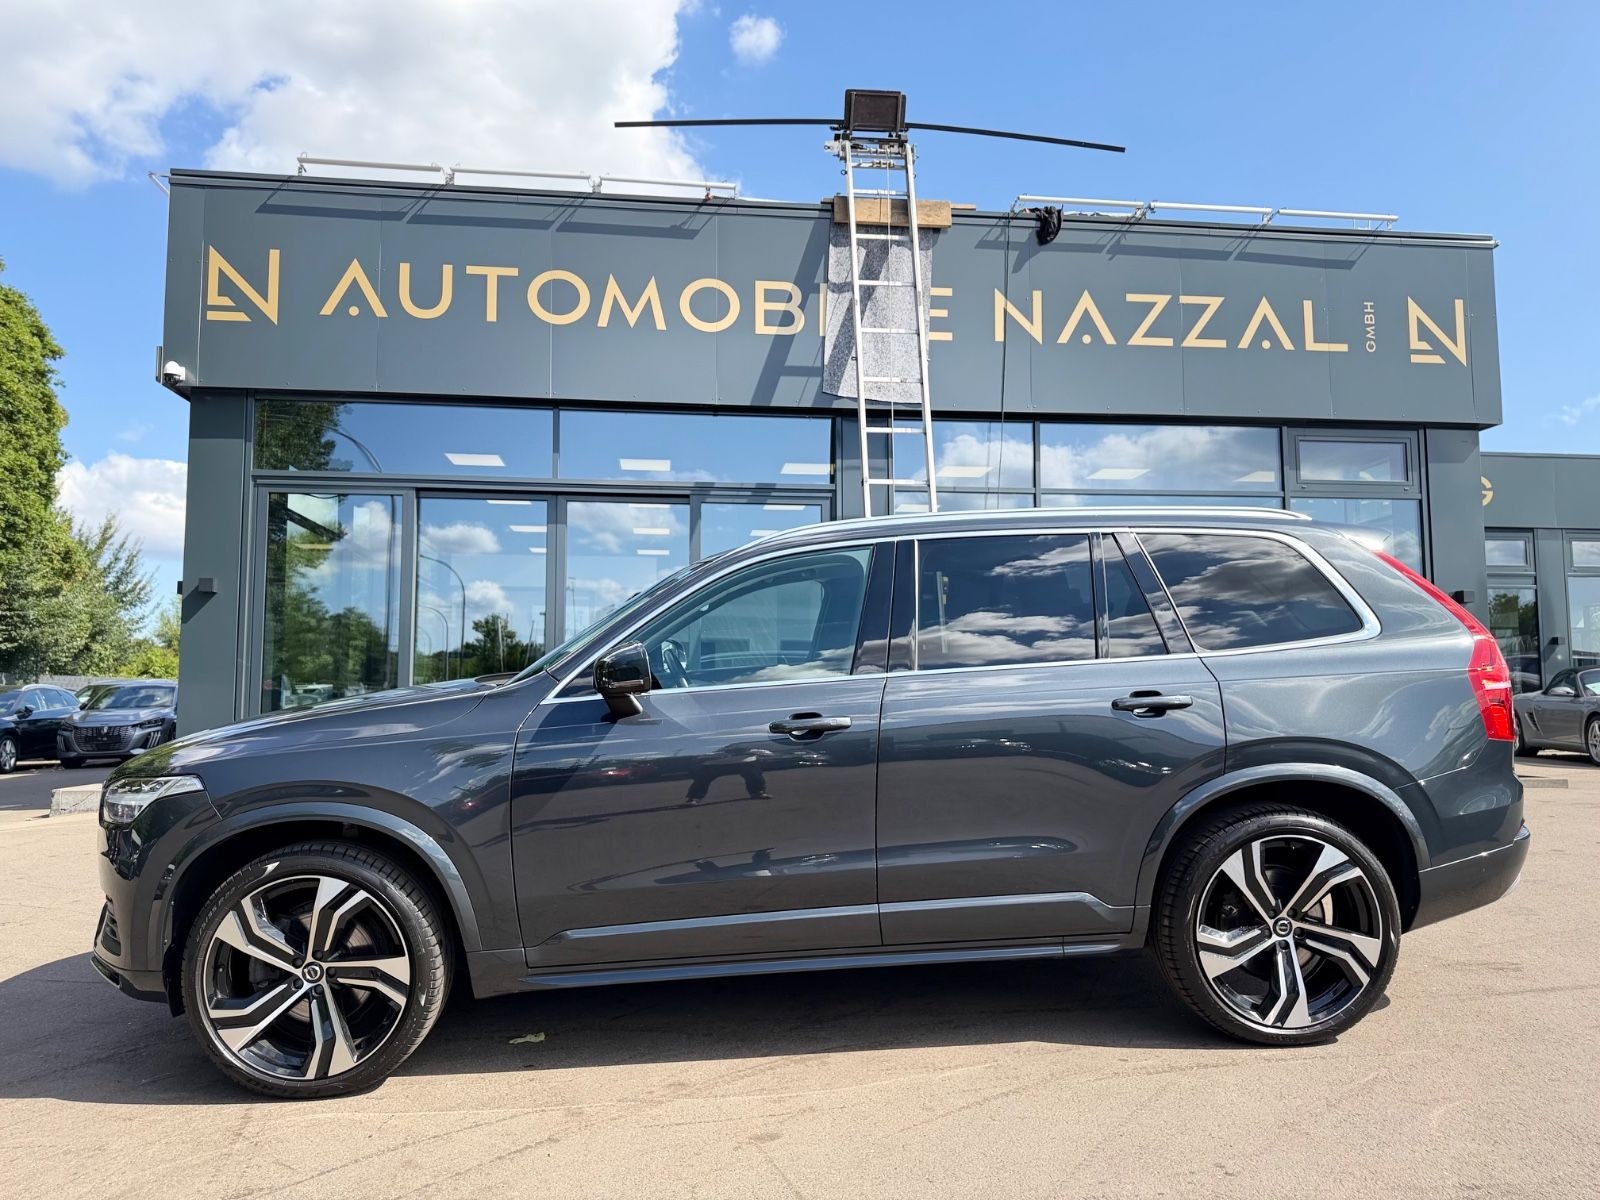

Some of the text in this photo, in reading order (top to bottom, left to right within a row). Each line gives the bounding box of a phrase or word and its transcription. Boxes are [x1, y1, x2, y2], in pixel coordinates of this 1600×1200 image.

[320, 258, 1348, 353] AUTOMOBIE NAZZAL
[1363, 301, 1376, 352] GMBH
